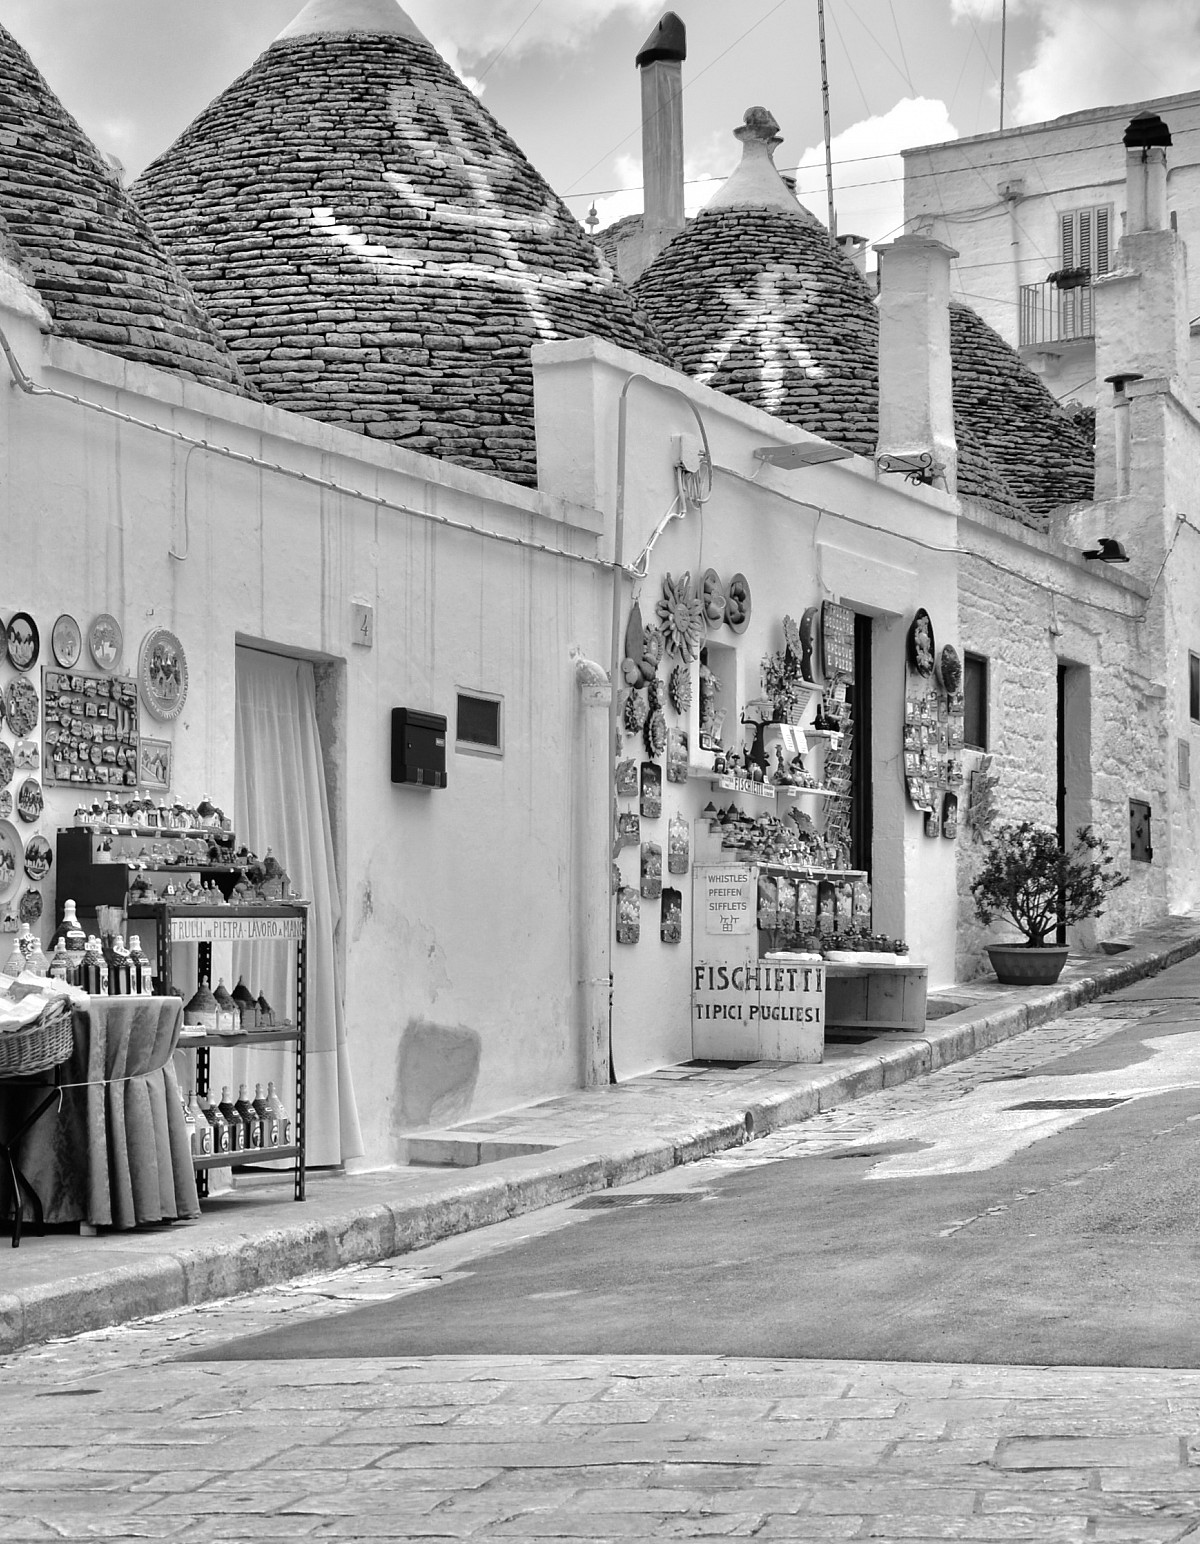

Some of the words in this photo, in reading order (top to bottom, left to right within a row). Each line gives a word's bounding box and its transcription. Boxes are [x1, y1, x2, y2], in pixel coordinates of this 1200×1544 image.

[360, 614, 368, 637] 4
[708, 874, 748, 883] WHISTLES
[708, 888, 742, 897] PFEIFEN
[709, 902, 747, 911] SIFFLETS
[213, 920, 243, 938] PIETRA
[248, 920, 278, 938] LAVORO
[694, 966, 823, 992] FISCHIETTI
[696, 1003, 742, 1020] TIPICI
[749, 1005, 821, 1023] PUGLIESI
